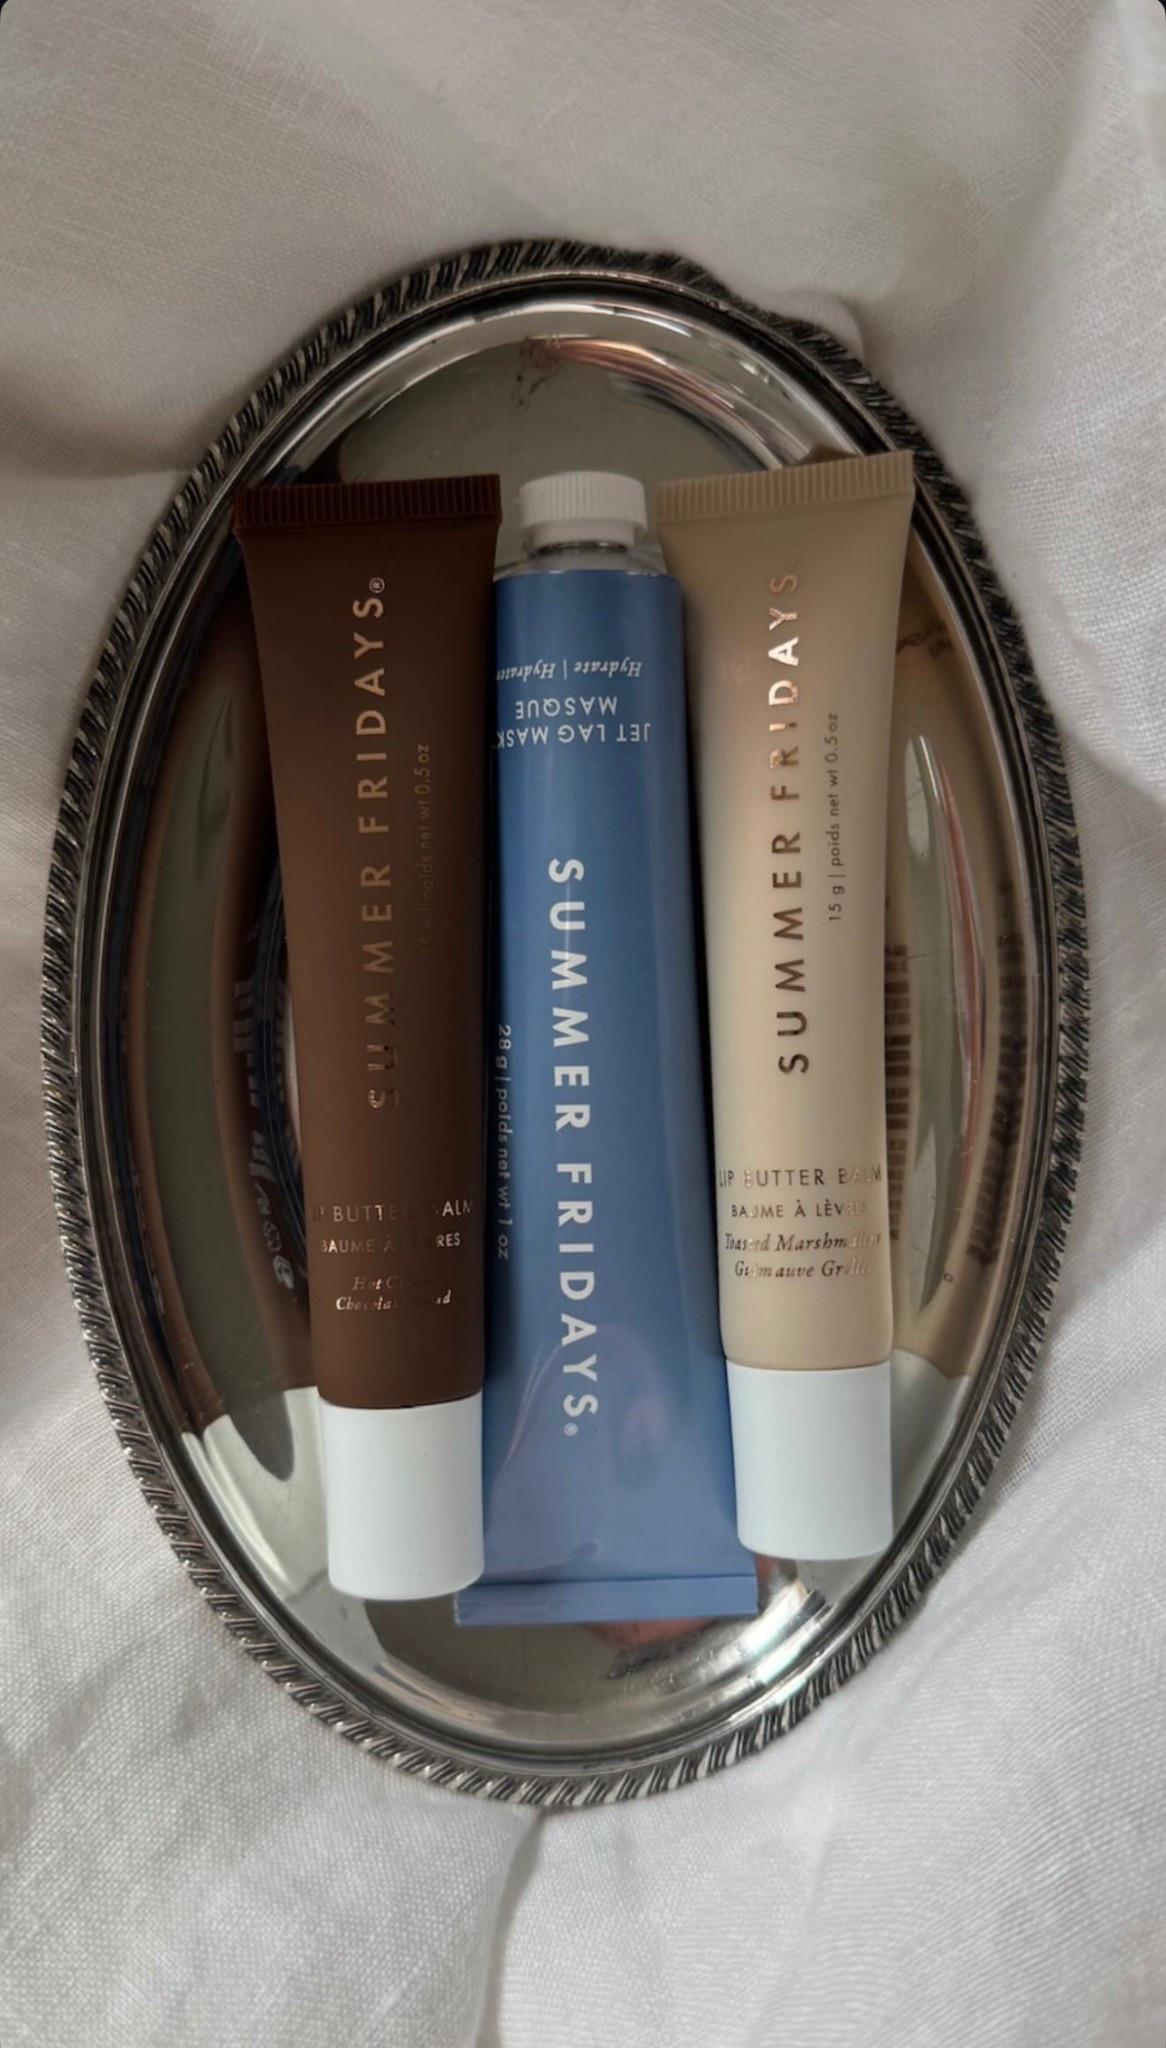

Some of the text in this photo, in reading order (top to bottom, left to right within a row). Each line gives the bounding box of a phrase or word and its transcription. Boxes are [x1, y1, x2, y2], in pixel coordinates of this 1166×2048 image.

[574, 656, 642, 678] Hydrate
[515, 696, 617, 719] MASQUE
[557, 724, 605, 743] LAG
[616, 723, 650, 742] JET
[828, 713, 839, 733] oz
[416, 743, 432, 765] oz
[824, 735, 839, 763] 0.5
[413, 766, 432, 796] 0.5
[829, 769, 840, 788] wt
[416, 800, 432, 821] wt
[827, 789, 840, 817] net
[417, 826, 433, 850] net
[825, 823, 845, 867] poids
[832, 885, 845, 895] g
[828, 903, 842, 921] 15
[771, 832, 809, 1073] SUMMER
[359, 862, 400, 1109] SUMMER
[548, 858, 591, 1131] SUMMER
[498, 1024, 512, 1050] 28
[496, 1087, 514, 1142] poids
[498, 1149, 511, 1179] net
[718, 1170, 734, 1187] LIP
[744, 1169, 826, 1188] BUTTER
[498, 1185, 511, 1208] wt
[333, 1204, 411, 1223] BUTTE
[432, 1198, 474, 1218] ALM
[731, 1204, 784, 1219] BAUME
[794, 1198, 807, 1218] À
[498, 1217, 513, 1226] 1
[498, 1234, 509, 1261] oz
